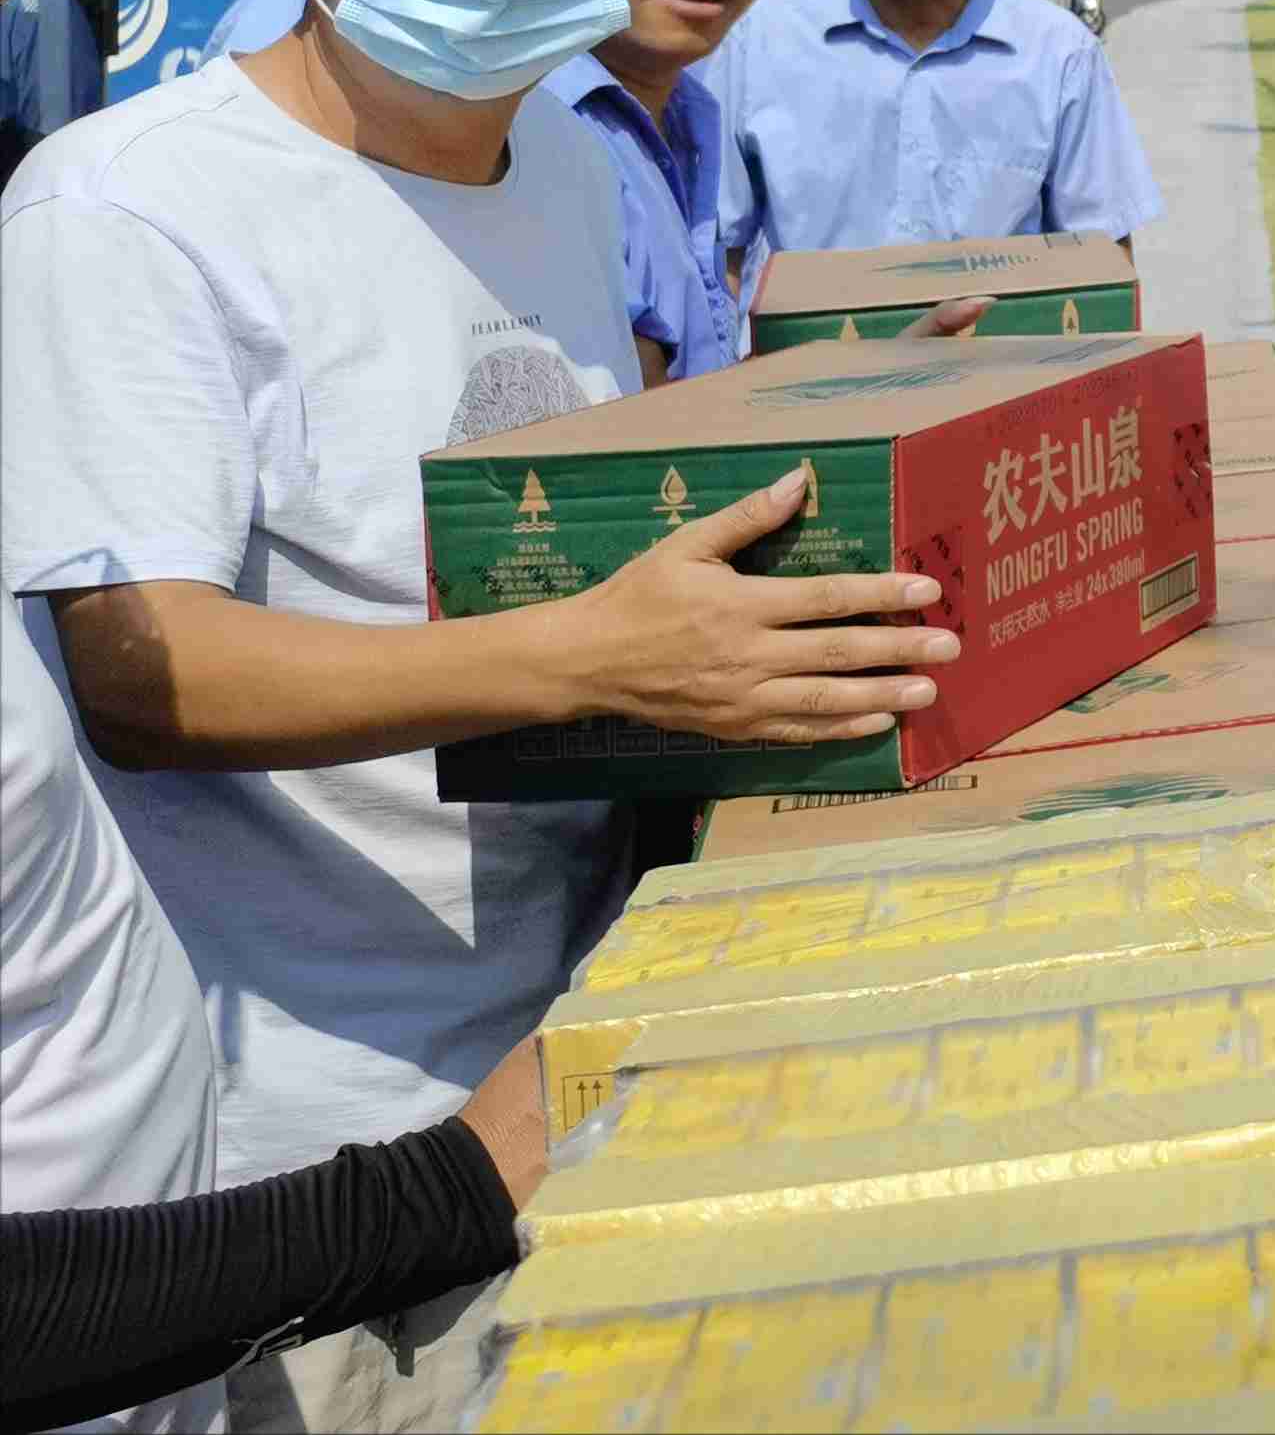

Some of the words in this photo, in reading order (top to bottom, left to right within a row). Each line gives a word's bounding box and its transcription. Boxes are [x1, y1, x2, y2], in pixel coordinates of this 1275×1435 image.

[983, 405, 1142, 546] 农夫山泉
[987, 529, 1068, 605] NONGFU
[1075, 497, 1143, 562] SPRING
[989, 597, 1050, 647] 饮用天然水
